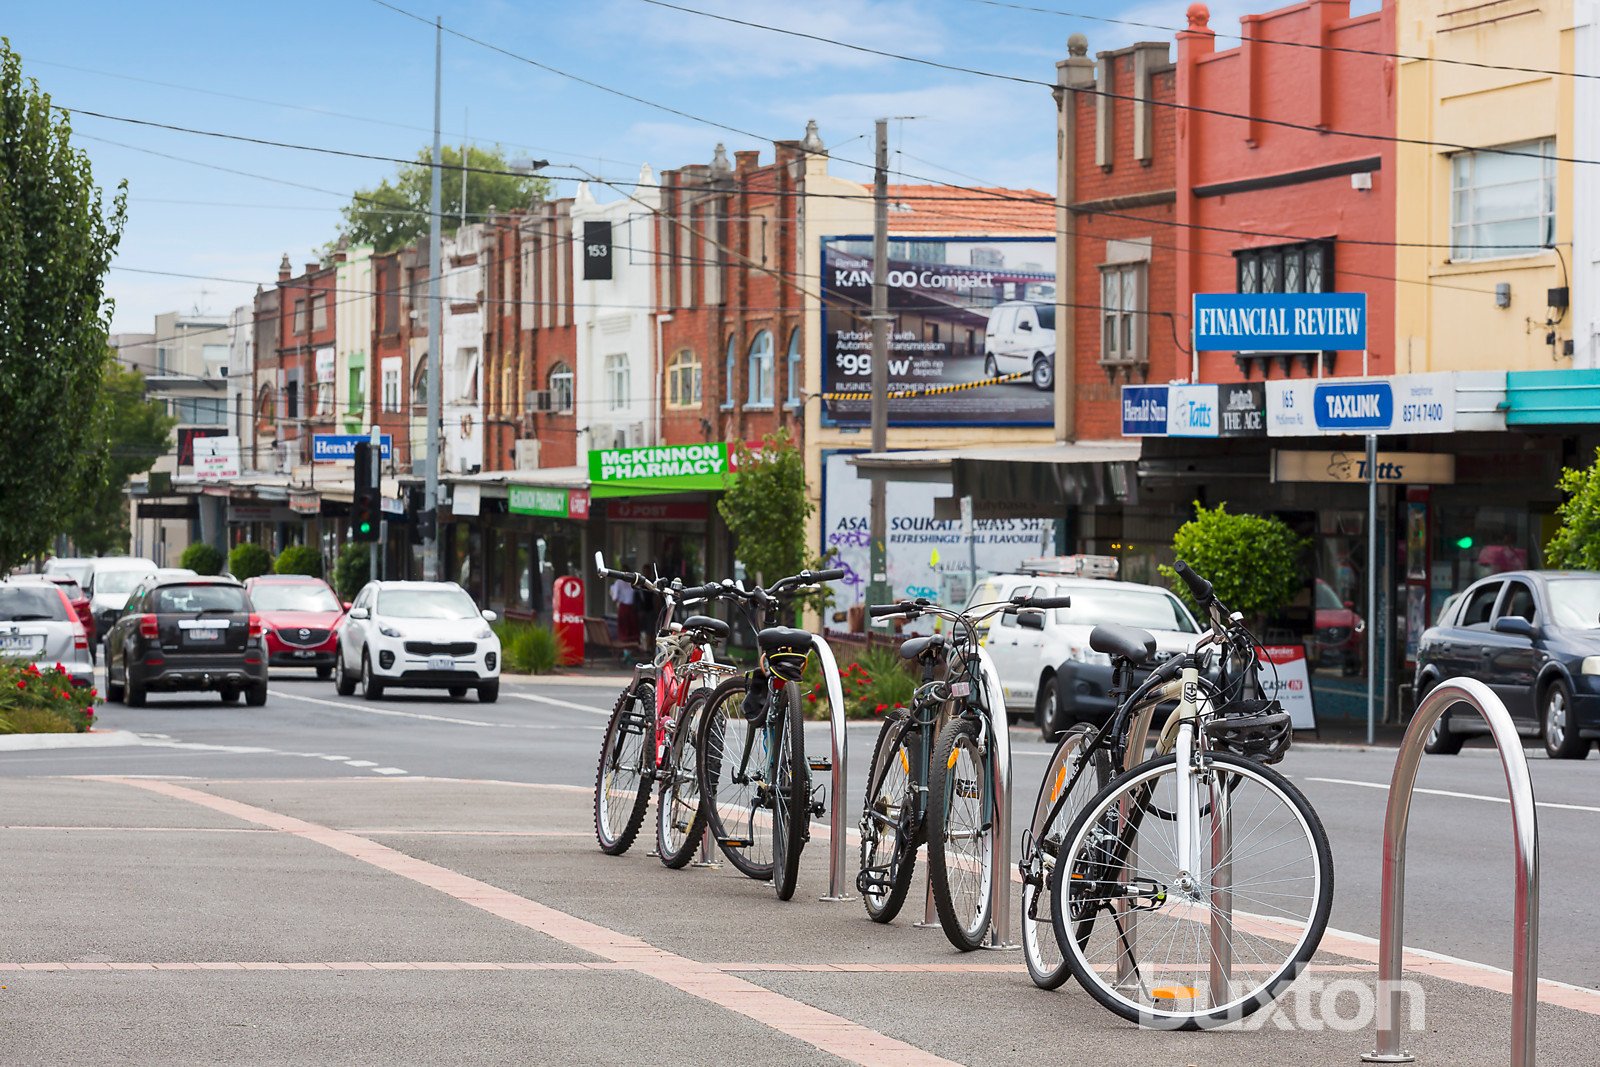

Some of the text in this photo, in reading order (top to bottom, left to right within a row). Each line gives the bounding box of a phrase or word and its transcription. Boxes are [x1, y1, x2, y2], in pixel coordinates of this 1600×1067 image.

[587, 245, 608, 257] 153
[835, 258, 868, 268] Renault
[835, 270, 993, 290] KANOO Compact
[1199, 307, 1361, 336] FINANCIAL REVIEW
[836, 330, 862, 341] Turbo
[894, 330, 916, 341] with
[912, 359, 932, 368] with
[912, 368, 942, 377] deposit
[1282, 390, 1294, 408] 165
[1325, 393, 1381, 419] TAXLINK
[1124, 400, 1167, 421] Herald Sun
[1189, 401, 1212, 428] Tatts
[1403, 404, 1443, 422] 8574 7400
[1222, 411, 1263, 430] THE AGE
[601, 445, 720, 466] McKINNON
[601, 459, 725, 480] PHARMACY
[1356, 460, 1405, 480] Ttts
[633, 505, 668, 517] POST
[890, 534, 960, 544] REFRESHINGLY
[1263, 680, 1288, 691] CASH
